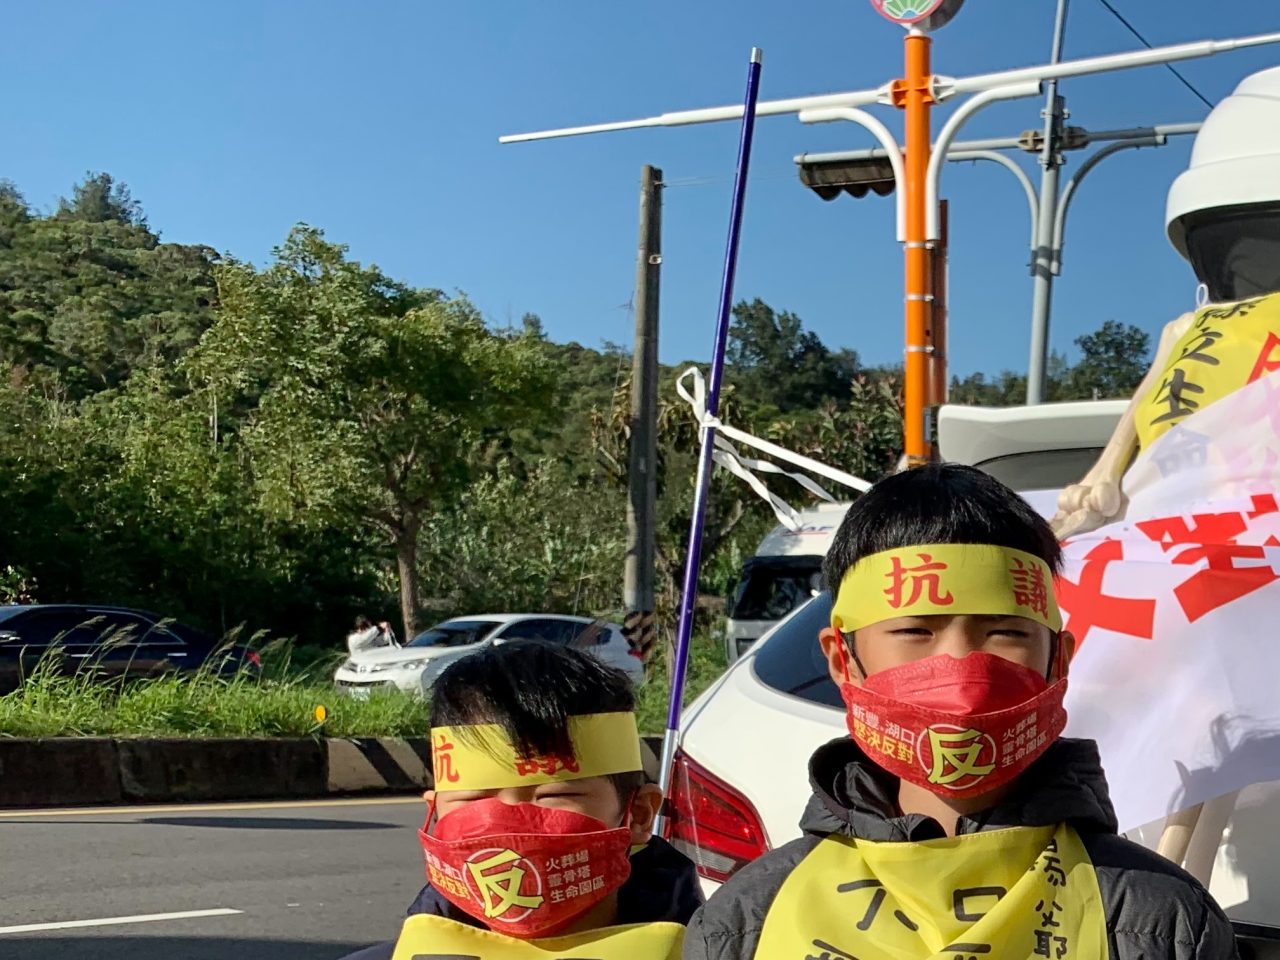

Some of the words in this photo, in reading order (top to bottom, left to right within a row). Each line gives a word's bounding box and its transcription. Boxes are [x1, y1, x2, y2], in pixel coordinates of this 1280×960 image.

[884, 553, 1049, 620] 抗議
[853, 717, 914, 764] 堅決反對
[926, 728, 996, 784] 反
[466, 849, 545, 919] 反
